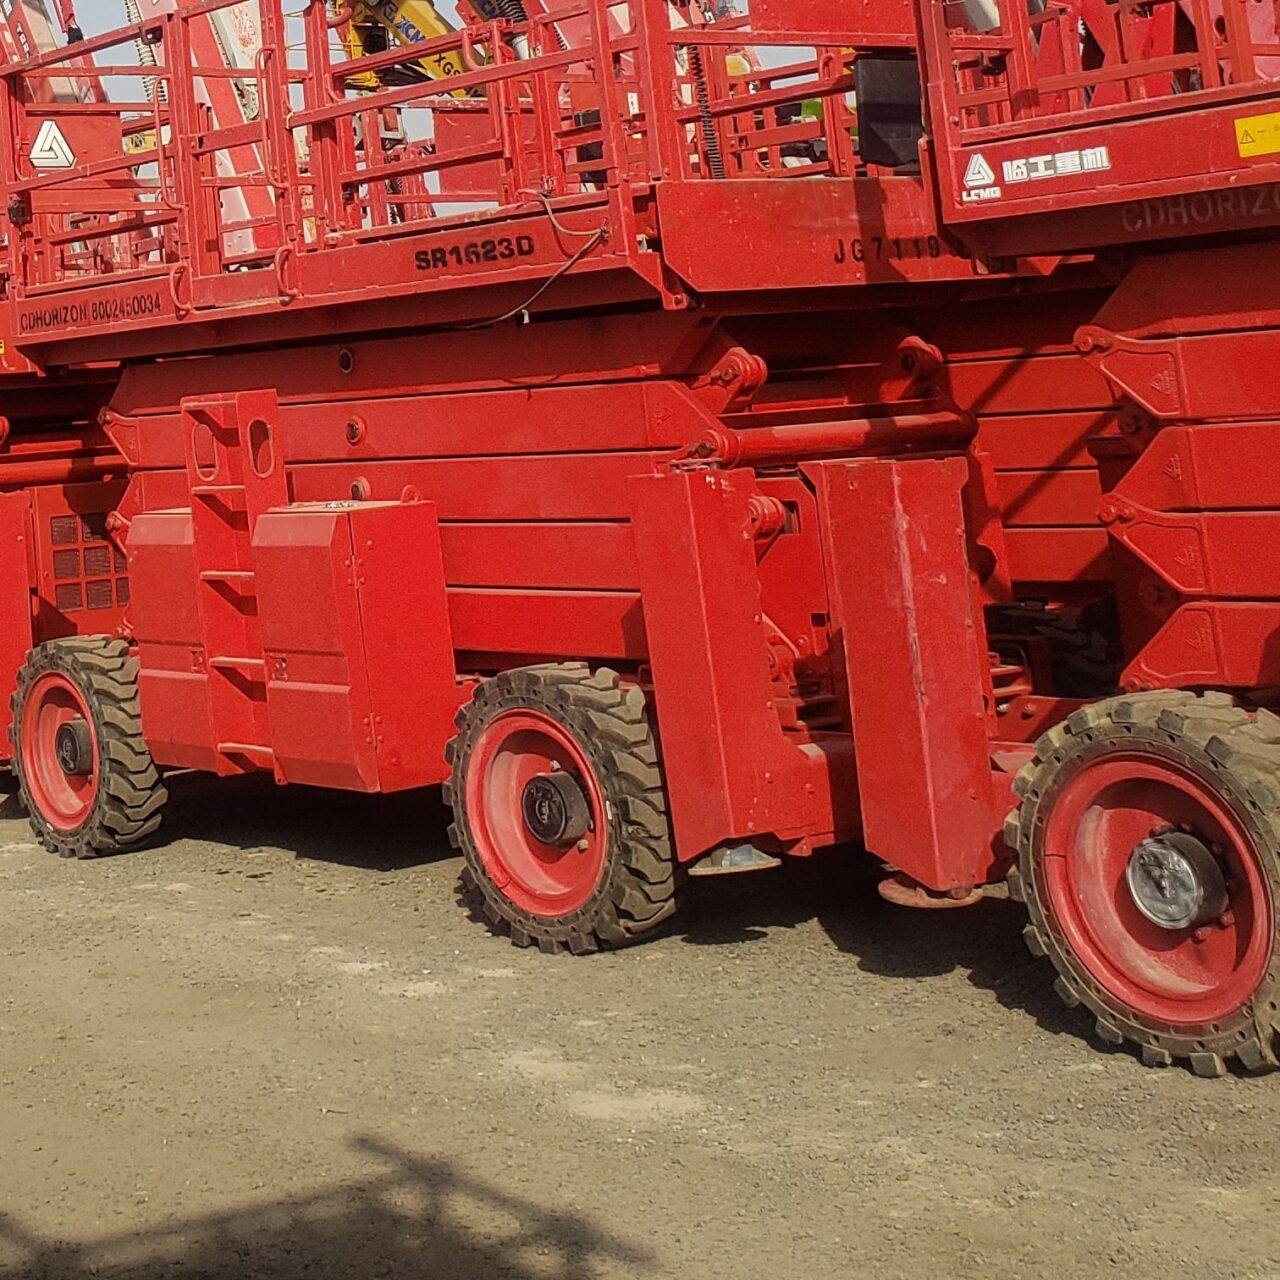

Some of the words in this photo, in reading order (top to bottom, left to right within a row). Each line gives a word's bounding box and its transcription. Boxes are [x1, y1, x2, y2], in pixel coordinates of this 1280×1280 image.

[1001, 146, 1110, 184] 临工重机
[415, 236, 535, 270] SR1623D
[21, 305, 88, 331] CDHORIZON
